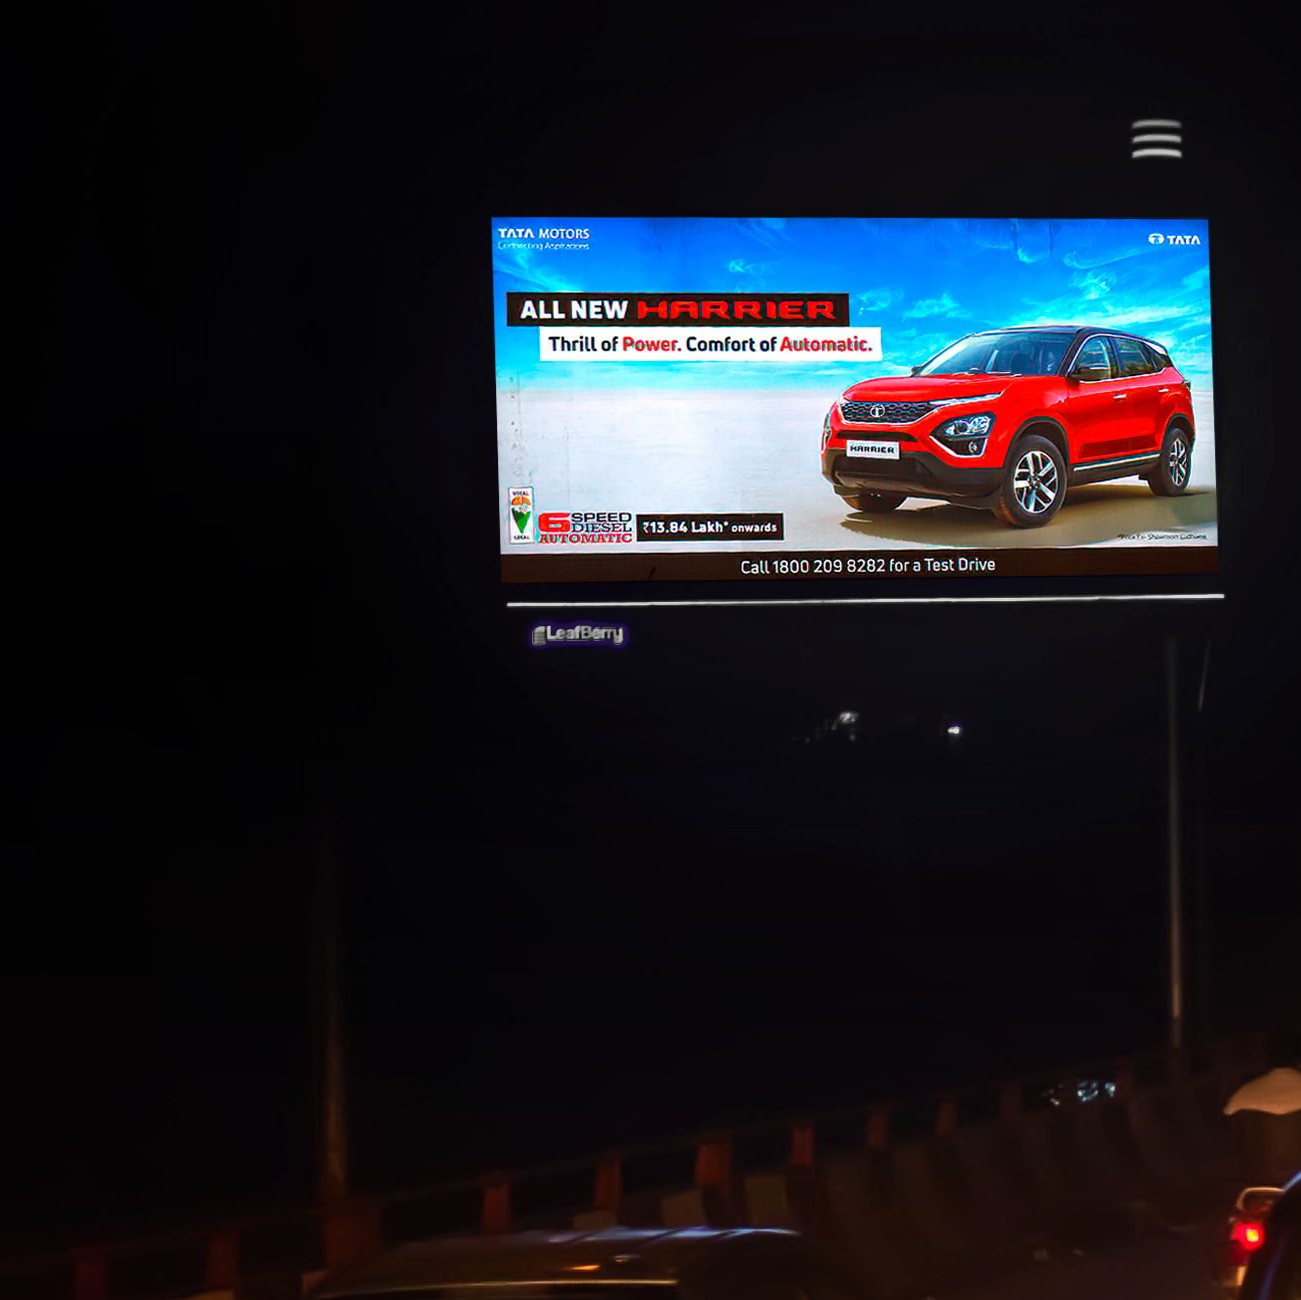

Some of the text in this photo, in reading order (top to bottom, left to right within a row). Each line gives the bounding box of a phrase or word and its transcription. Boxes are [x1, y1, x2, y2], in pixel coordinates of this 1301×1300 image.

[498, 228, 590, 239] TATA MOTORS
[1167, 235, 1201, 245] TATA
[520, 300, 836, 320] ALL NEW HARRIER
[548, 335, 872, 352] Thrill of Power. Comfort of Automatic.
[538, 512, 632, 533] 6 SPEED
[571, 522, 632, 533] DIESEL
[643, 520, 688, 534] ₹13.84
[731, 522, 777, 533] onwards
[539, 533, 633, 544] AUTOMATIC
[741, 557, 996, 574] Call 1800 209 8282 for a Test Drive
